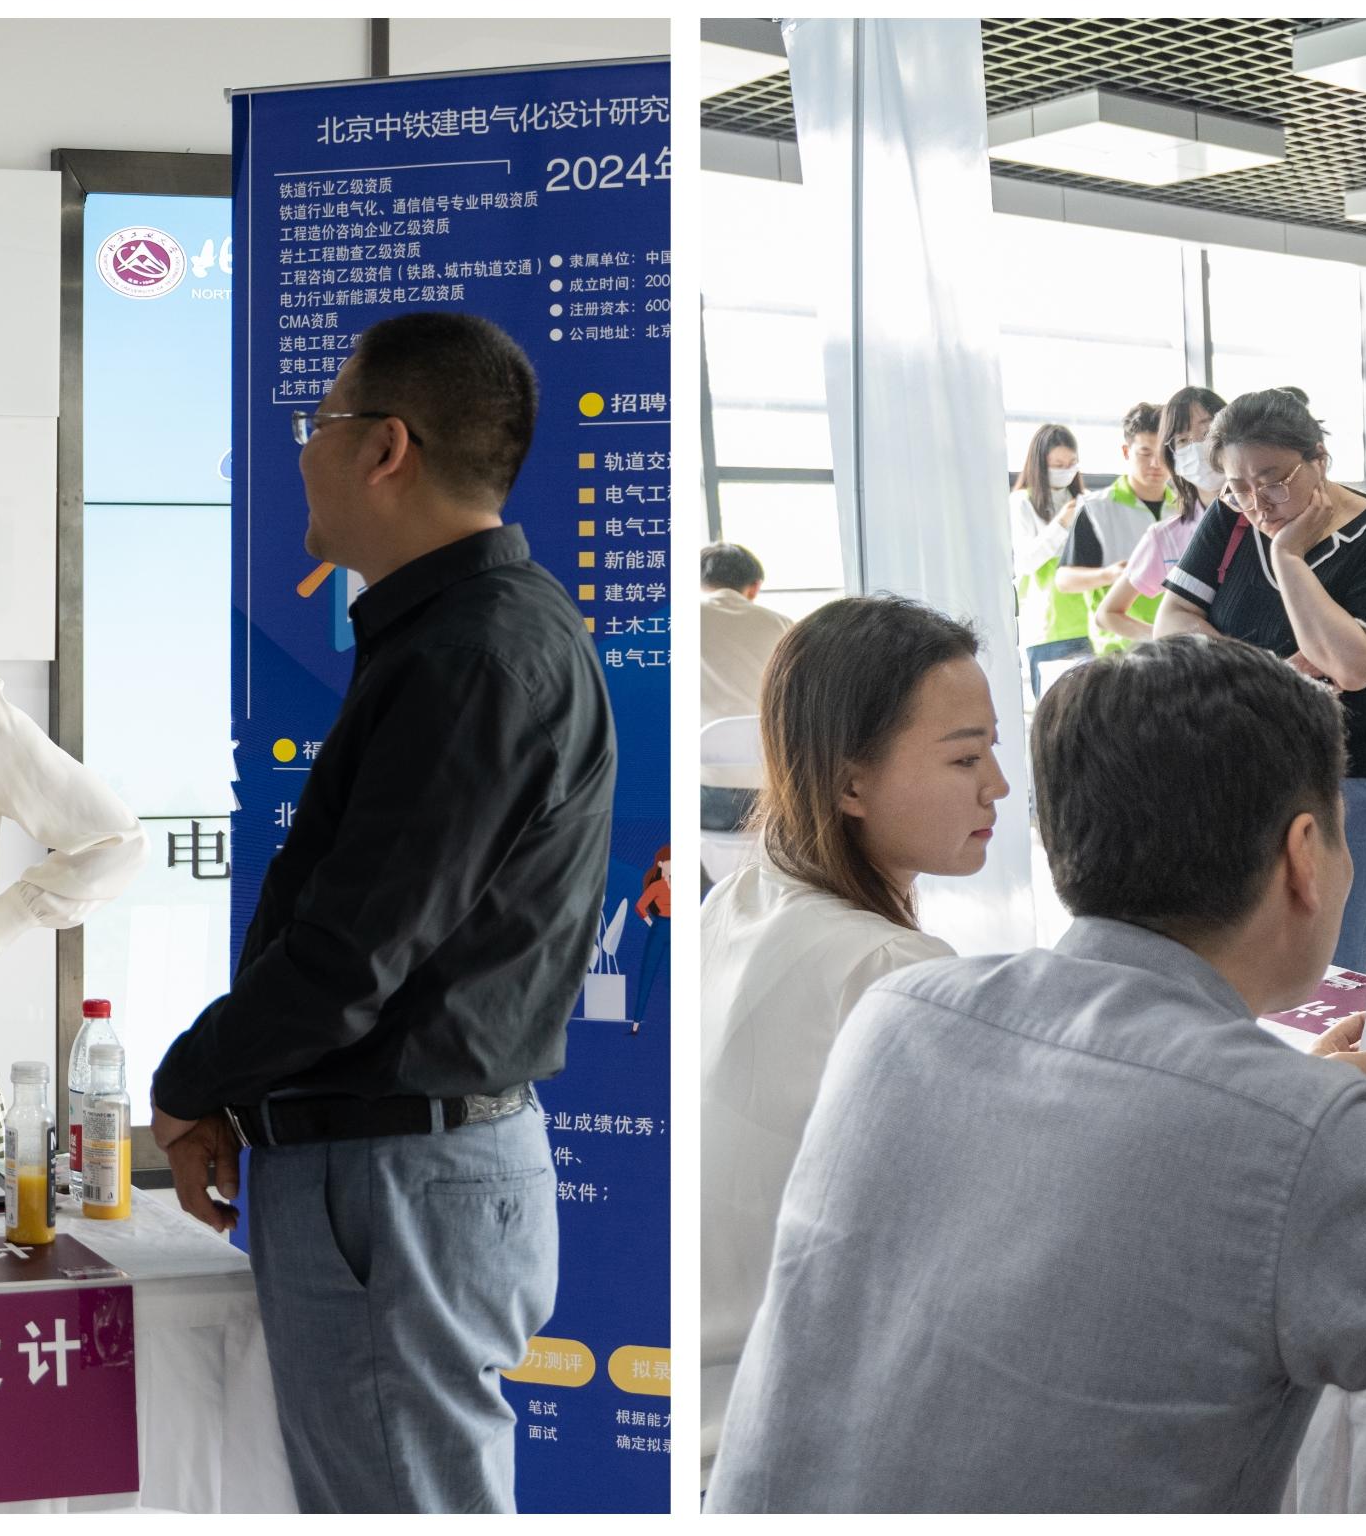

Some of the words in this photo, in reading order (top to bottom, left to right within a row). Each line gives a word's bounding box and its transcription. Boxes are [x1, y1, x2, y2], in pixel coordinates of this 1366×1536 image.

[279, 176, 393, 200] 铁道行业乙级资质
[279, 190, 539, 222] 铁道行业电气化、通信信号专业甲级资质
[279, 217, 451, 243] 工程造价咨询企业乙级资质
[279, 241, 422, 265] 岩土工程勘查乙级资质
[279, 284, 466, 309] 电力行业新能源发电乙级资质
[279, 312, 339, 330] CMA资质
[604, 451, 671, 472] 轨道交
[605, 484, 671, 505] 电气工
[605, 517, 671, 537] 电气工
[604, 550, 666, 570] 新能源
[604, 582, 666, 603] 建筑学
[605, 616, 671, 636] 土木工
[605, 648, 671, 668] 电气工
[167, 820, 231, 880] 电
[528, 1399, 558, 1417] 笔试
[528, 1425, 558, 1441] 面试
